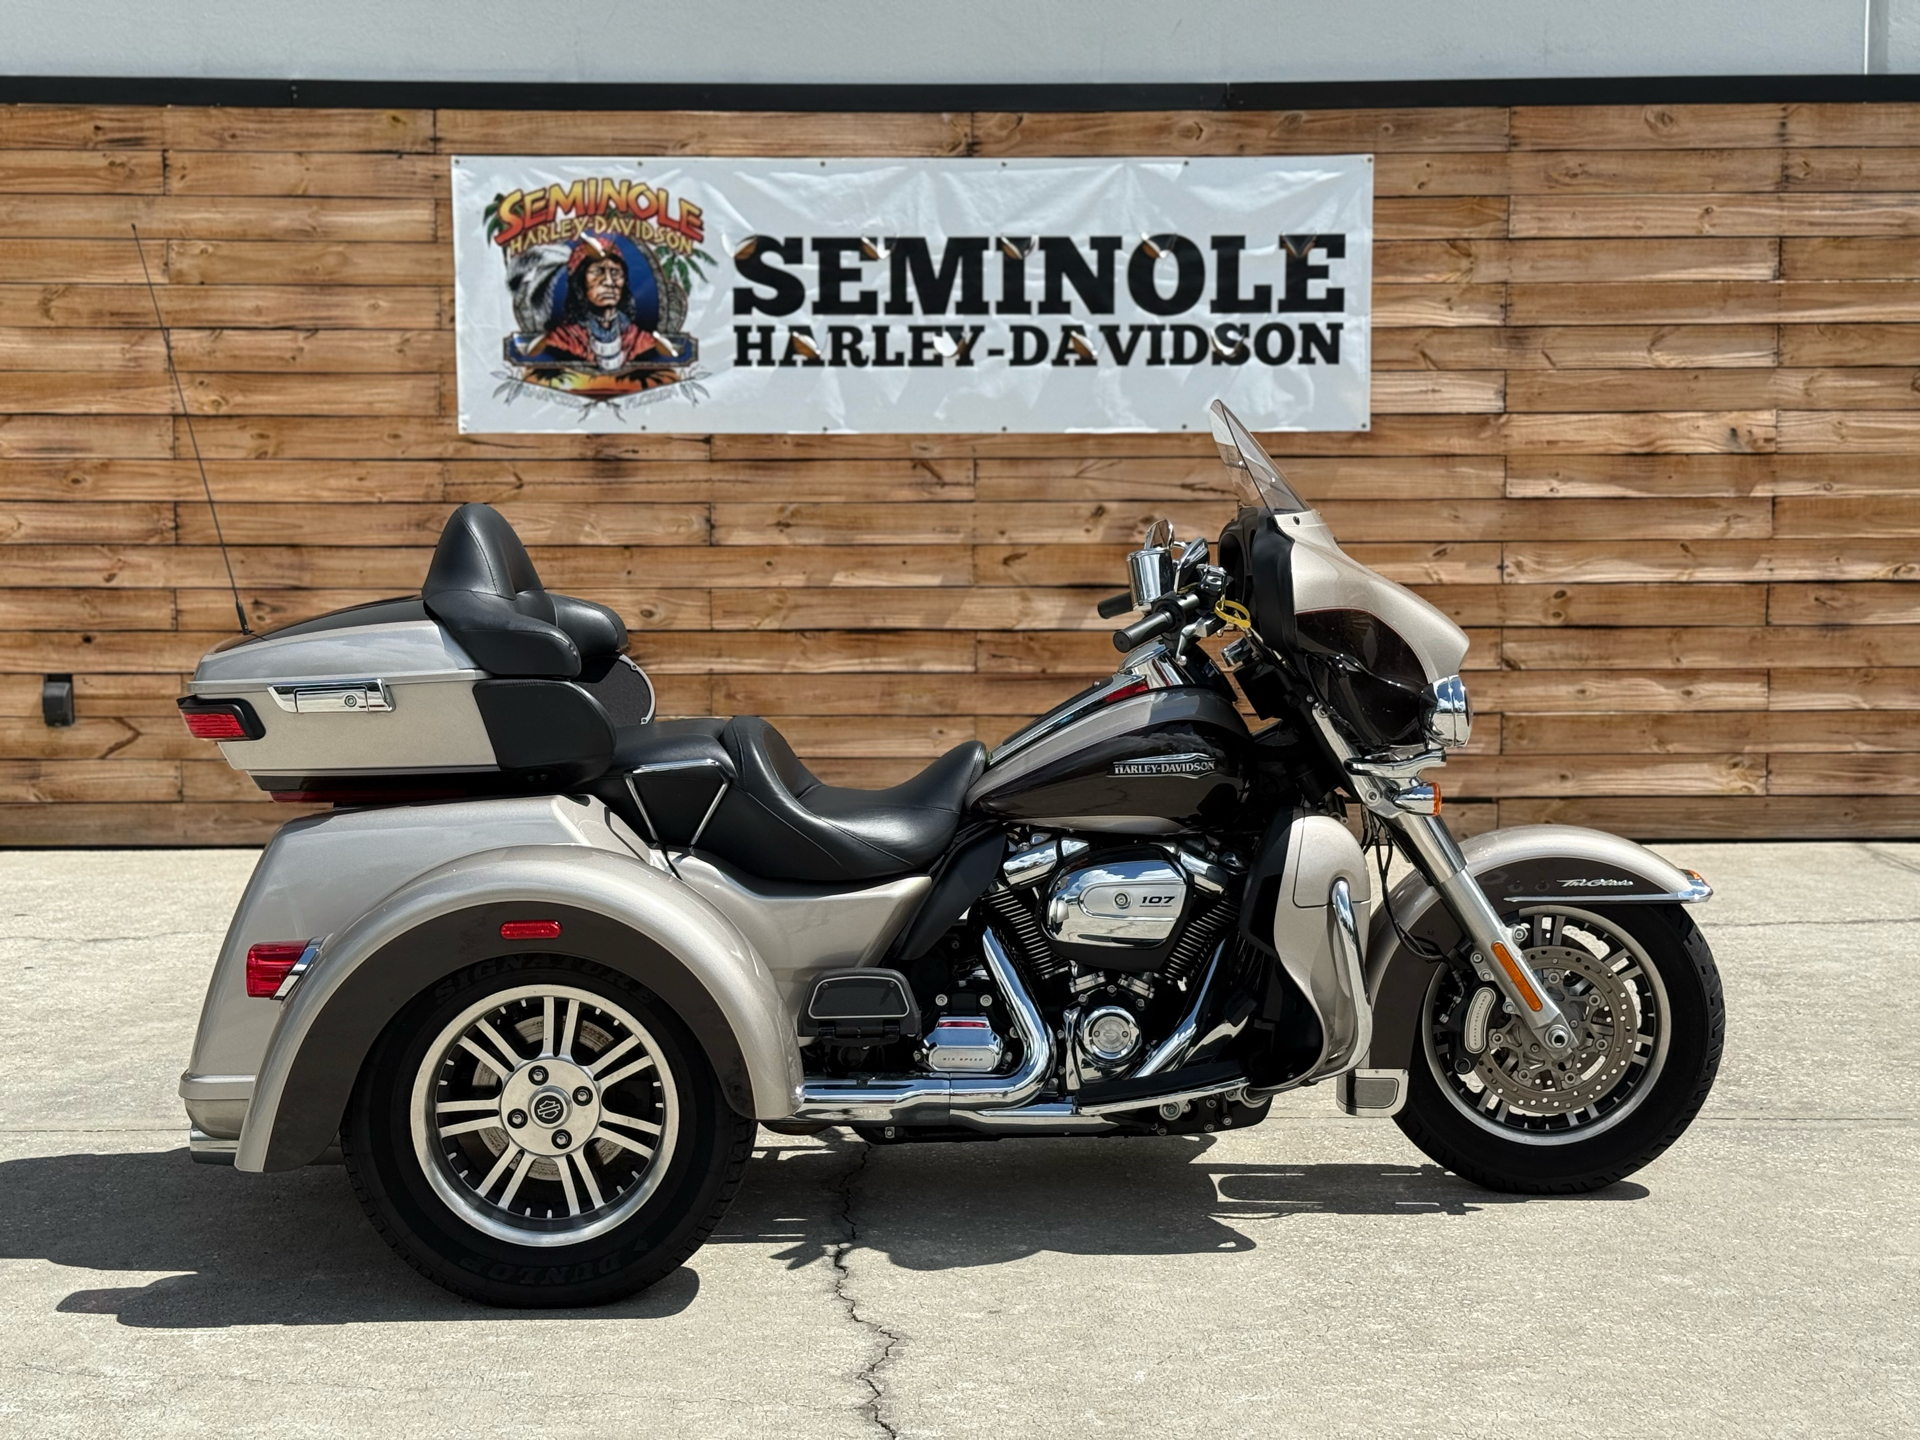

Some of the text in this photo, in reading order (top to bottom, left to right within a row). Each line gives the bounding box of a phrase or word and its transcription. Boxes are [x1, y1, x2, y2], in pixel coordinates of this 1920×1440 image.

[494, 177, 704, 246] SEMINOLE
[509, 216, 695, 256] HARLEY-DAVIDSON
[733, 234, 1346, 317] SEMINOLE
[733, 322, 1344, 367] HARLEY-DAVIDSON
[1114, 761, 1215, 774] HARLEY-DAVIDSON
[1141, 896, 1176, 904] 107
[434, 953, 659, 1005] SIGNATURE
[458, 1250, 624, 1287] DUNLOP
